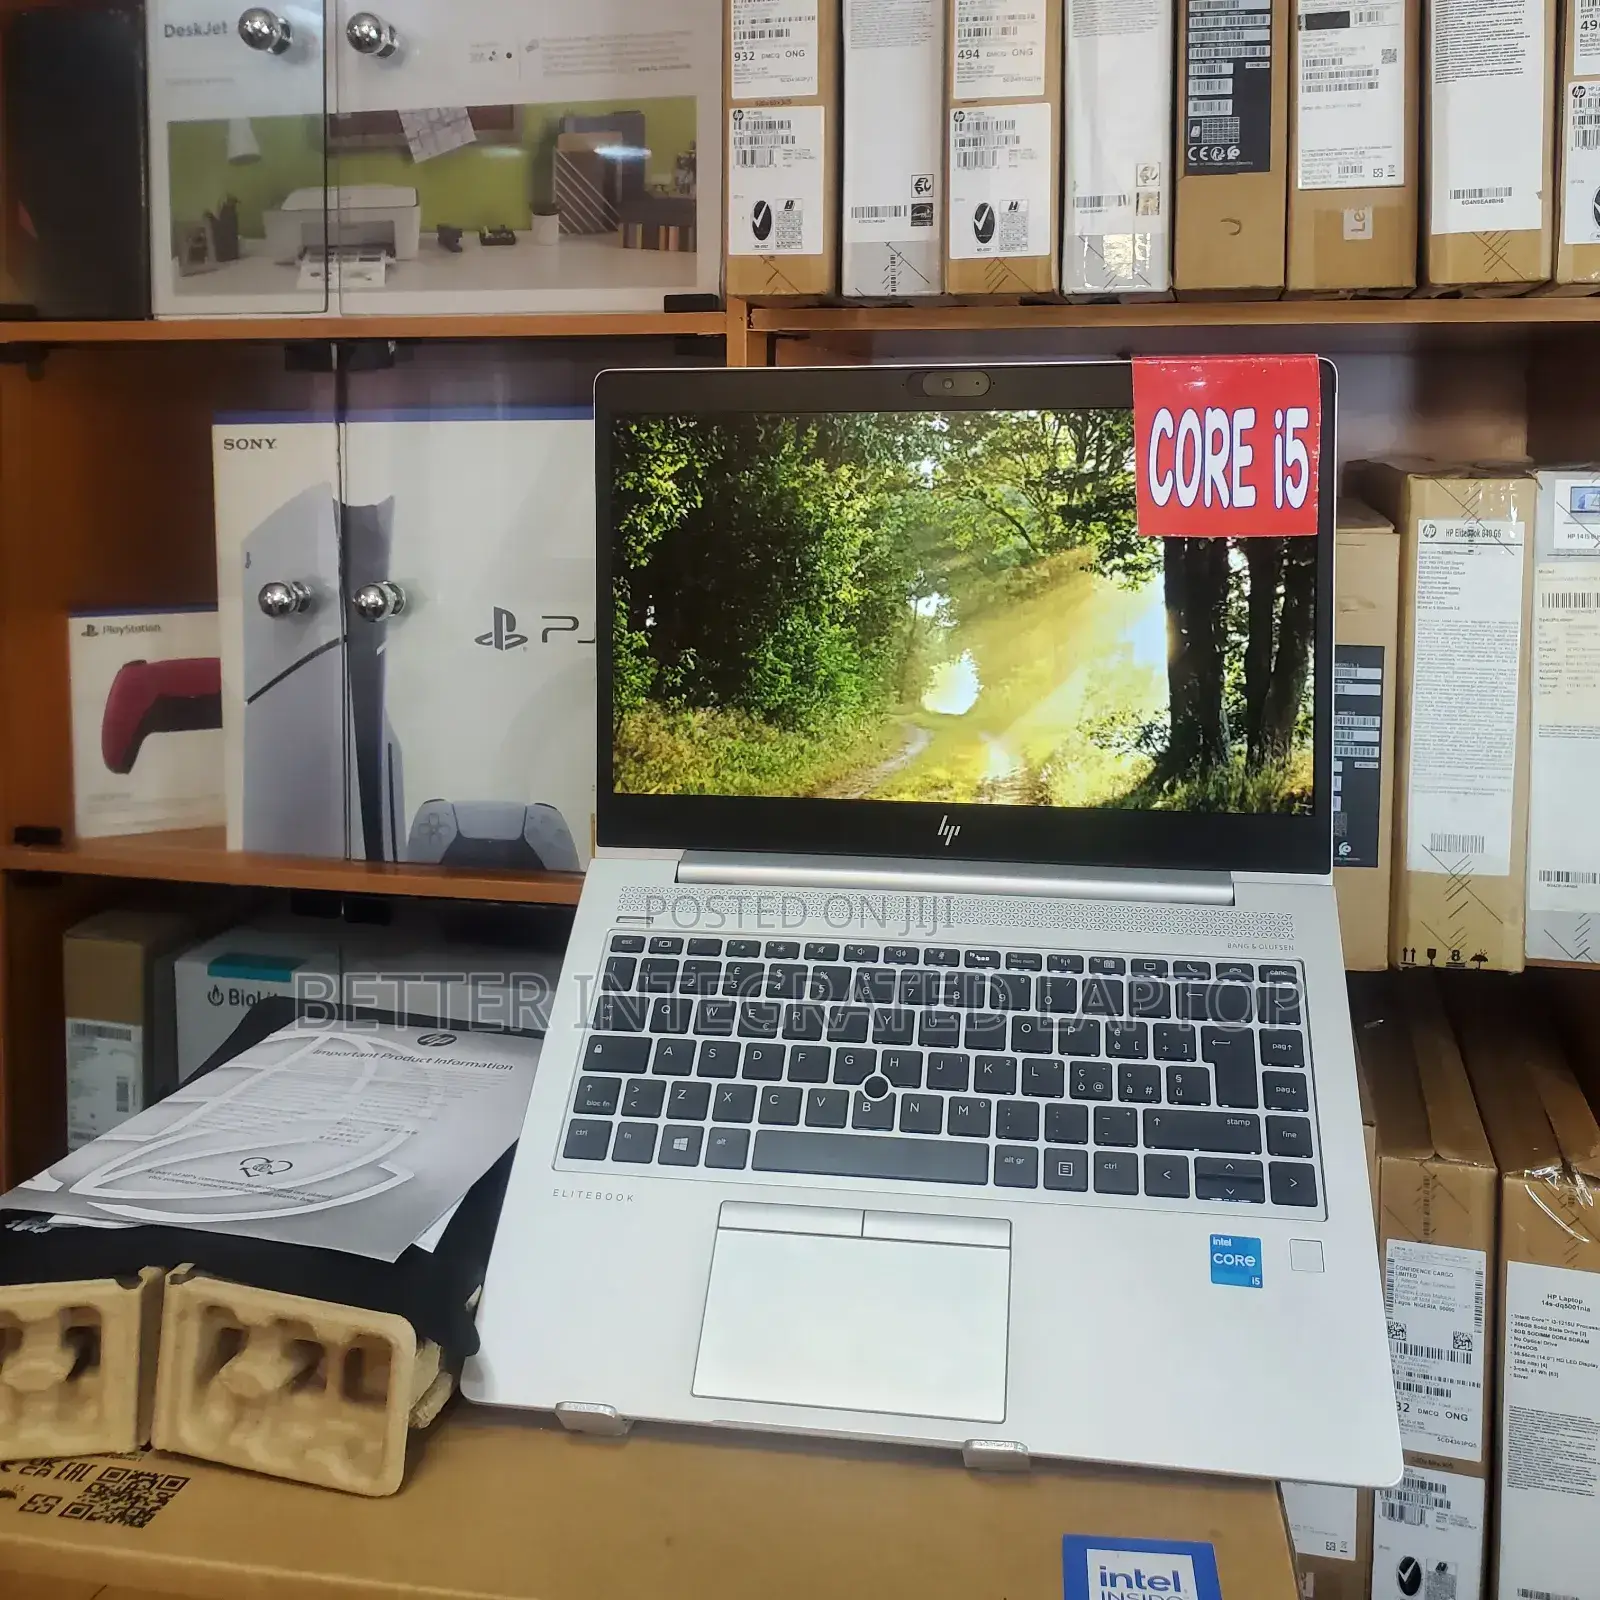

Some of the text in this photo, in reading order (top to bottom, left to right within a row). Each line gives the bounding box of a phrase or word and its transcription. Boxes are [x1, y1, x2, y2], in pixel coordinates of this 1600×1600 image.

[164, 20, 228, 38] DeskJet
[734, 51, 755, 61] 932
[958, 49, 980, 59] 494
[1012, 48, 1033, 56] ONG
[1572, 85, 1586, 98] hp
[224, 438, 276, 450] SONY
[1148, 406, 1310, 509] CORE i5
[1423, 524, 1436, 538] hp
[1446, 528, 1453, 537] HP
[102, 622, 161, 635] PlayStation
[541, 615, 595, 644] P
[938, 815, 960, 846] hp
[776, 969, 782, 977] $
[863, 973, 870, 981] &
[687, 979, 694, 987] 2
[731, 980, 738, 989] 3
[819, 985, 825, 993] 5
[863, 986, 870, 995] 6
[908, 989, 914, 997] 7
[953, 991, 960, 999] 8
[999, 994, 1006, 1002] 9
[661, 1005, 670, 1014] Q
[706, 1007, 718, 1016] W
[748, 1009, 757, 1018] E
[793, 1012, 800, 1020] R
[837, 1013, 845, 1022] T
[883, 1016, 892, 1024] Y
[762, 1022, 769, 1031] €
[929, 1018, 937, 1027] U
[1022, 1023, 1031, 1032] O
[1068, 1026, 1075, 1035] P
[417, 1033, 457, 1046] hp
[664, 1047, 674, 1056] A
[708, 1049, 716, 1058] S
[753, 1051, 762, 1060] D
[313, 1049, 514, 1071] Important Product Information
[798, 1053, 806, 1062] F
[845, 1056, 854, 1065] G
[890, 1058, 899, 1067] H
[937, 1061, 943, 1070] J
[984, 1064, 992, 1073] K
[1032, 1067, 1039, 1076] L
[1092, 1082, 1104, 1092] @
[1145, 1087, 1153, 1095] #
[1276, 1086, 1290, 1094] pag
[678, 1090, 687, 1099] Z
[723, 1092, 732, 1102] X
[770, 1095, 778, 1104] C
[817, 1097, 826, 1106] V
[862, 1102, 871, 1112] B
[910, 1103, 919, 1112] N
[958, 1106, 969, 1116] M
[1226, 1118, 1250, 1126] stamp
[1283, 1130, 1296, 1138] fine
[553, 1189, 634, 1202] ELITEBOOK
[1213, 1237, 1232, 1246] intel
[1395, 1265, 1454, 1278] CONFIDENCE CARGO
[1559, 1295, 1583, 1304] Laptop
[1418, 1408, 1438, 1416] DMCQ
[1445, 1411, 1468, 1422] ONG
[1100, 1565, 1181, 1593] intel
